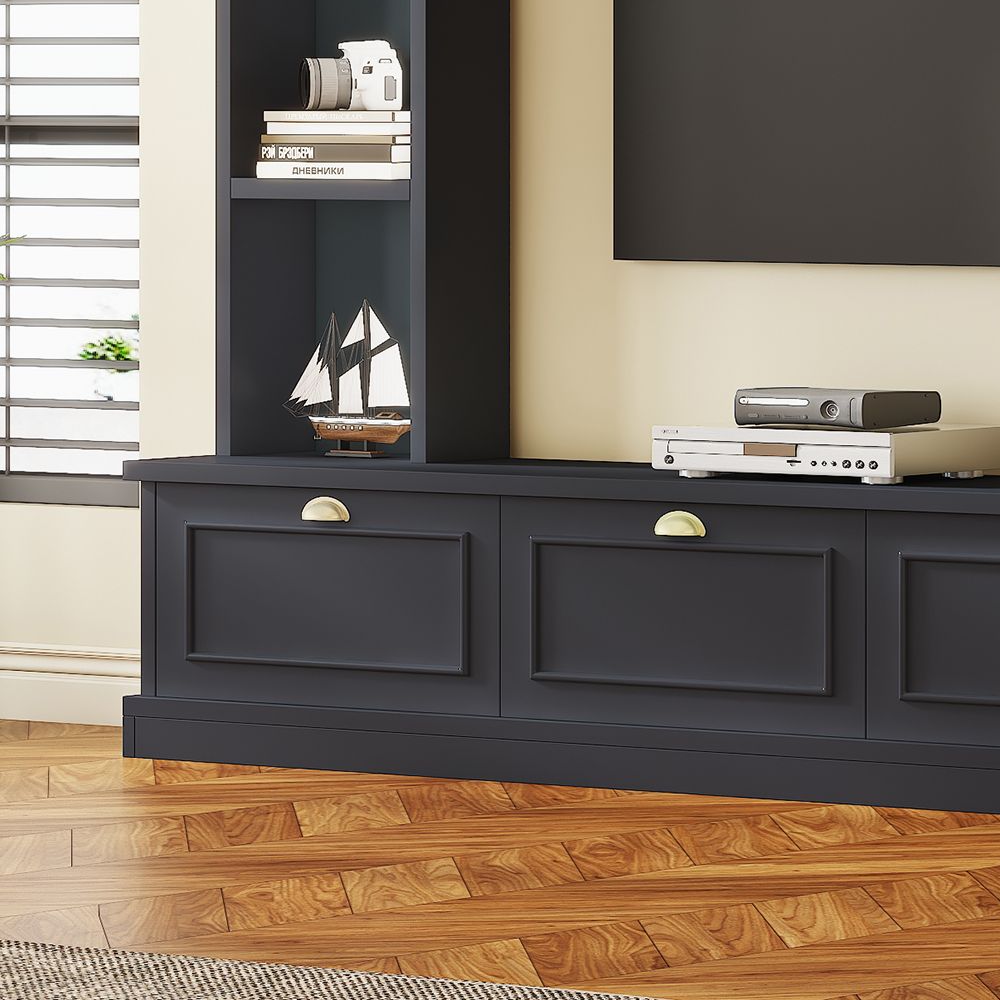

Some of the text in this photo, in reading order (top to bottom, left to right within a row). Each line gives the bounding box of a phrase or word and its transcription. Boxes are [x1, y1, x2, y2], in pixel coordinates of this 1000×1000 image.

[261, 144, 314, 160] РЭЙ БРЭДБЕРИ
[292, 166, 345, 176] ДНЕВНИКИ
